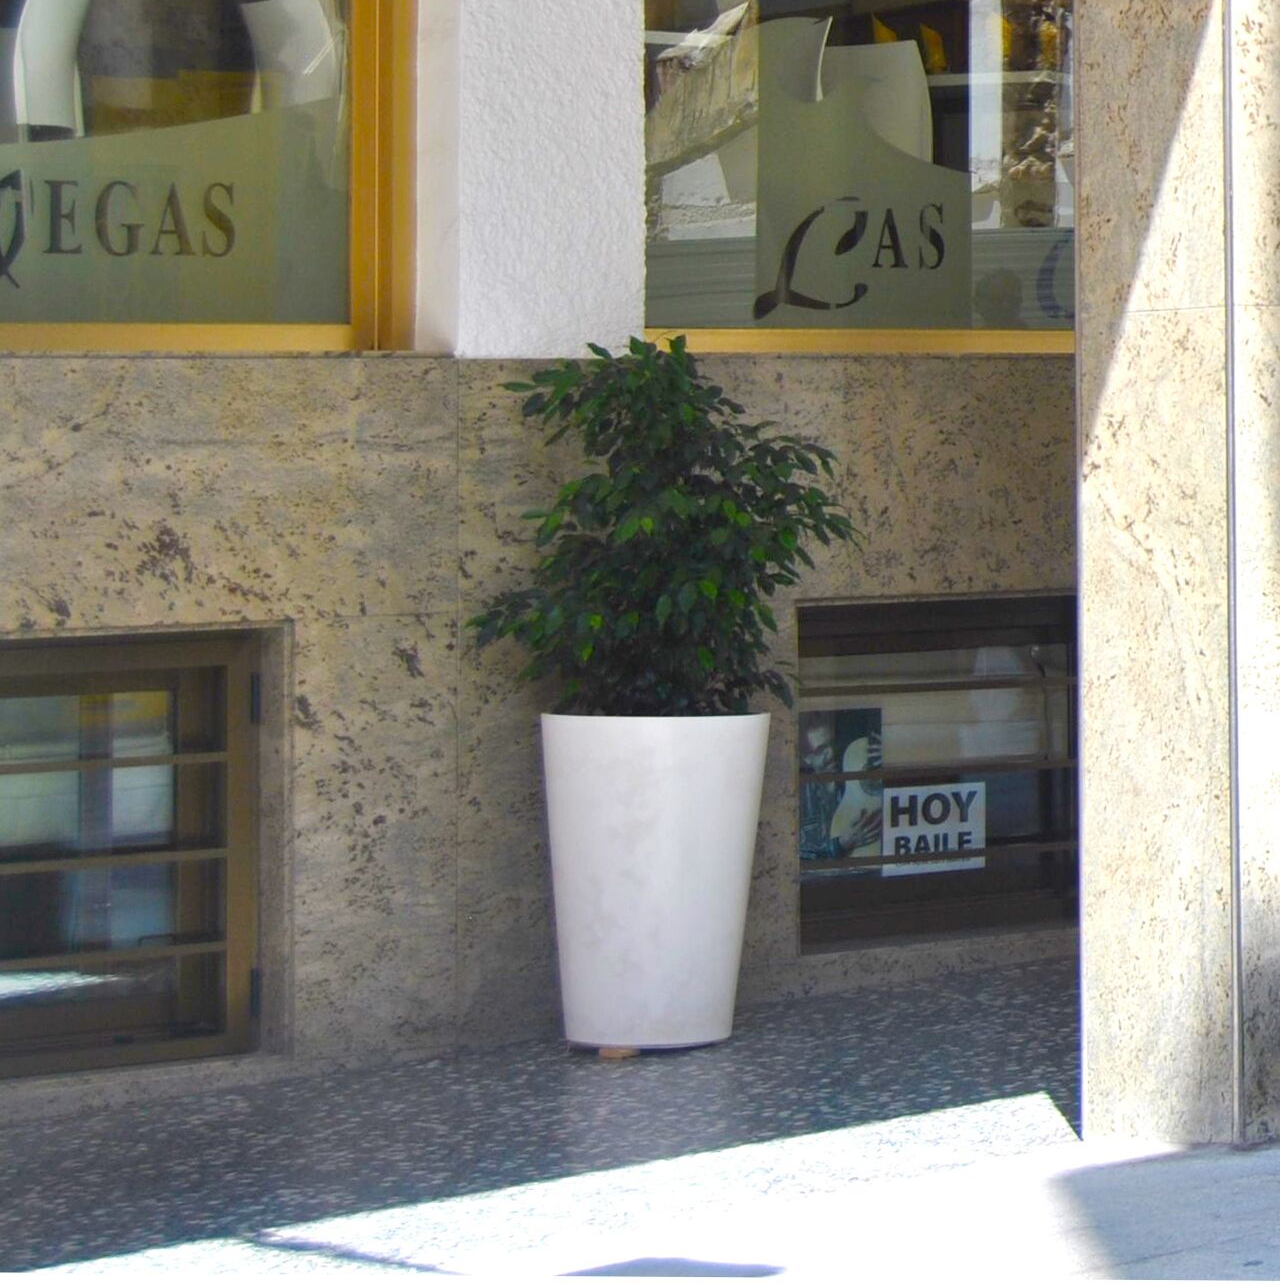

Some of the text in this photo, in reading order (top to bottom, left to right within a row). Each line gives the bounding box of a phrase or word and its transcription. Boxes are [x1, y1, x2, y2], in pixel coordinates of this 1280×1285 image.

[753, 196, 944, 320] LAS
[890, 790, 978, 828] HOY
[894, 831, 972, 857] BAILE
